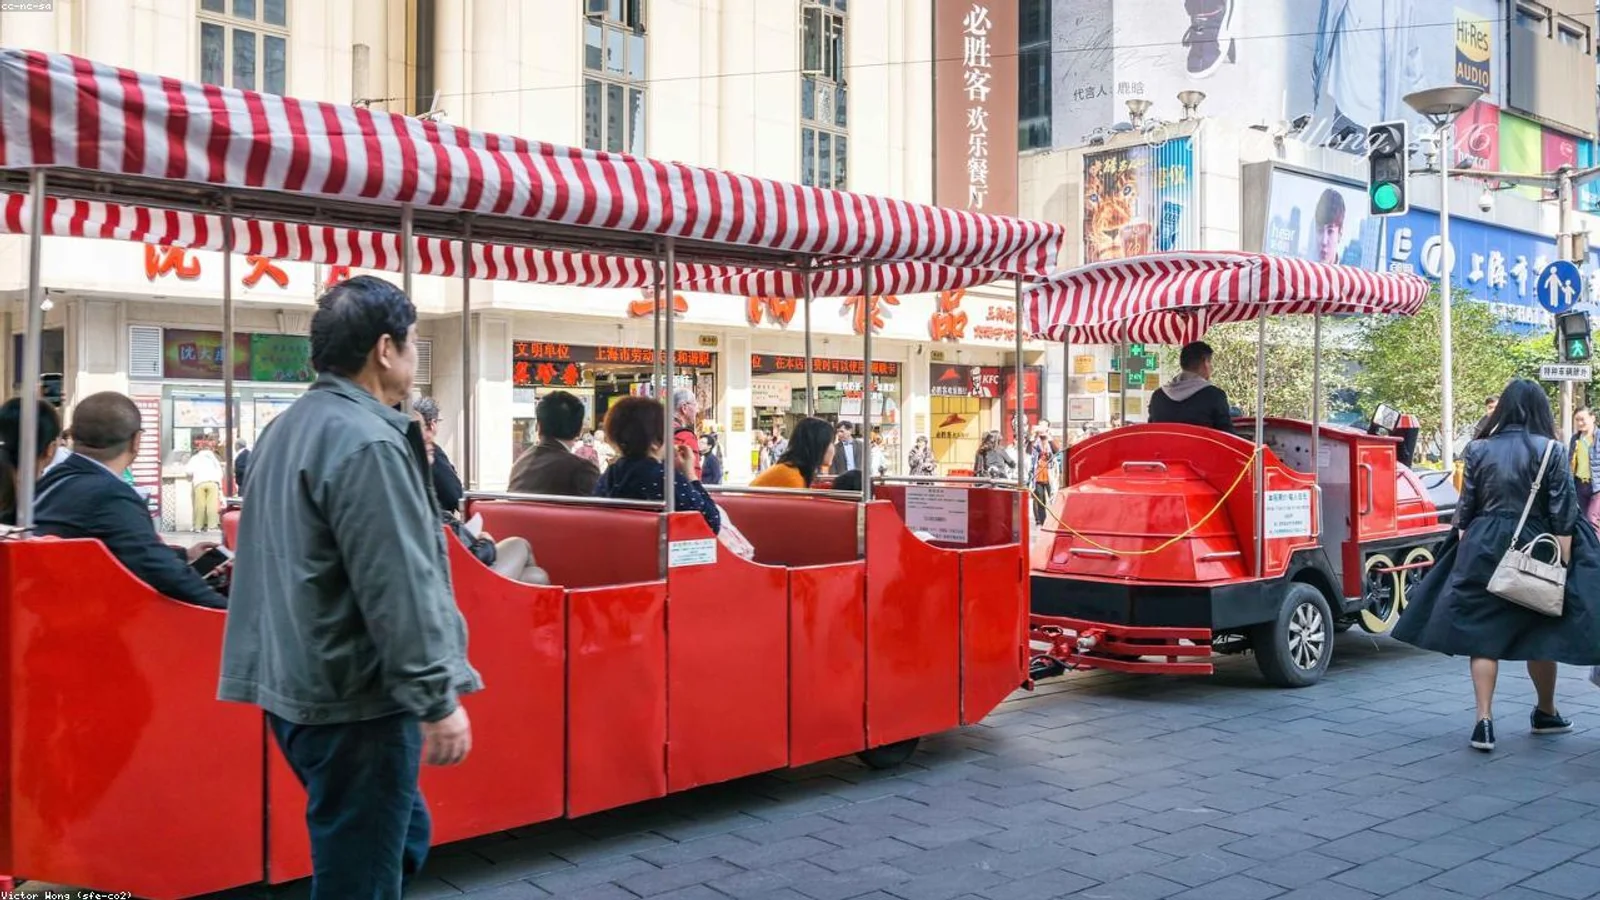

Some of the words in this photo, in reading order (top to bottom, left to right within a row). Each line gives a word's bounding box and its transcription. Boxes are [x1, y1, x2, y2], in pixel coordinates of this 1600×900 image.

[1456, 18, 1488, 51] Hi-Res
[962, 3, 992, 101] 必胜客
[1456, 61, 1489, 88] AUDIO
[966, 106, 989, 209] 欢乐餐厅
[515, 343, 570, 359] 文明单位
[982, 374, 999, 385] KFC
